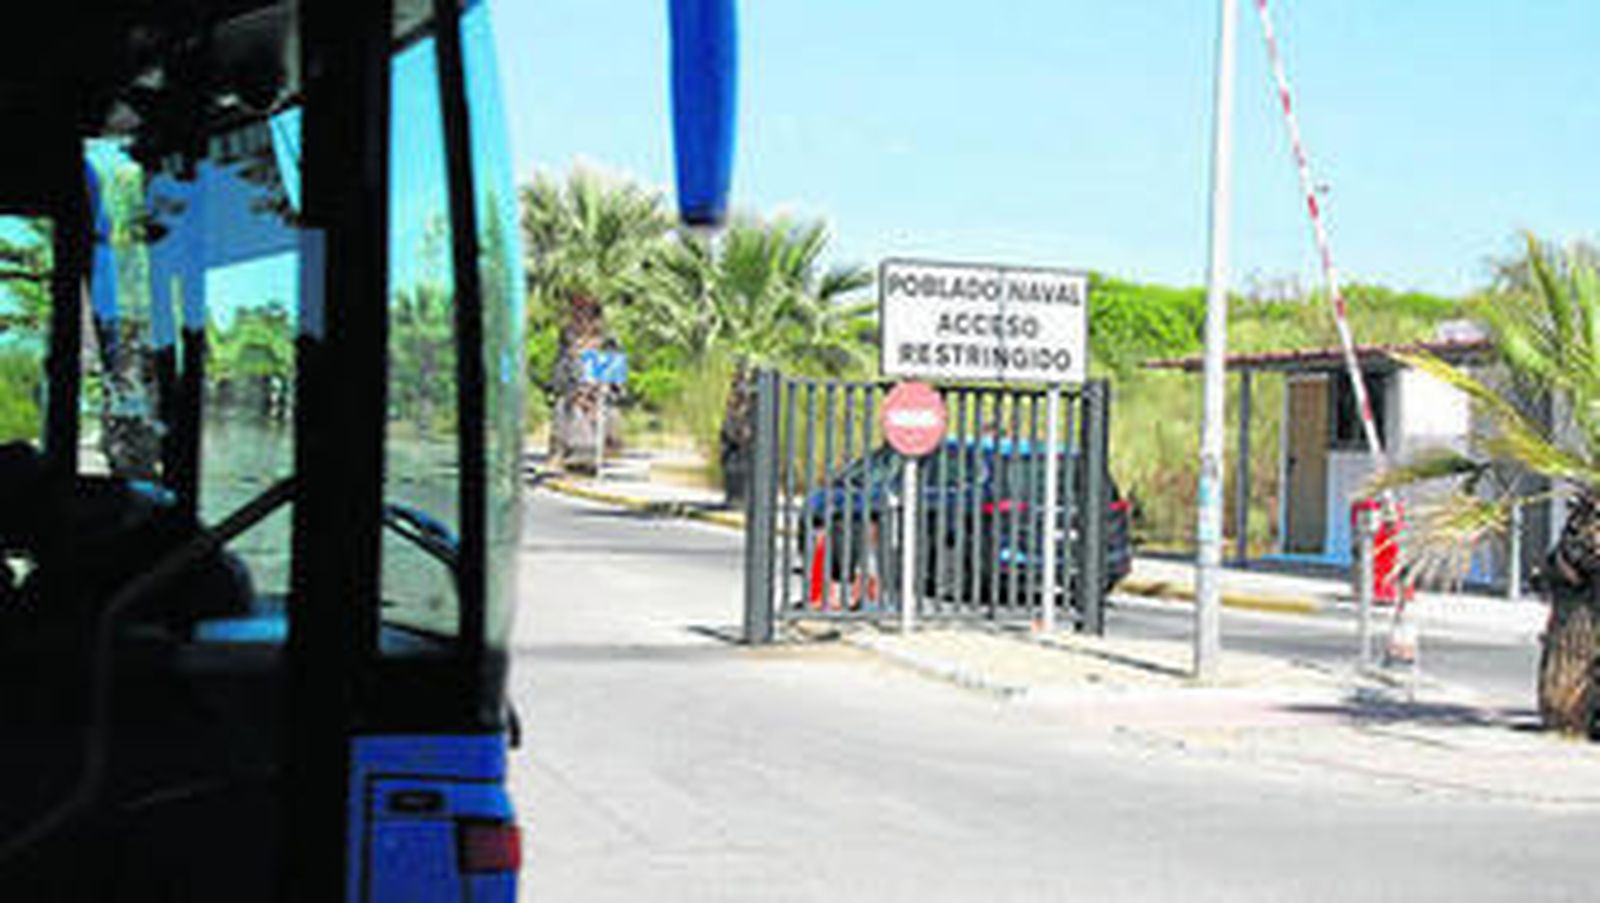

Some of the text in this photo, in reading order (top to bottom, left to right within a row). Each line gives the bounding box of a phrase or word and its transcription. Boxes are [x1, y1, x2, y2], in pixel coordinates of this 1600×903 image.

[887, 272, 1081, 306] POBLADO NAVAL
[936, 312, 1039, 339] ACCESO
[898, 343, 1072, 371] RESTRINGIDO
